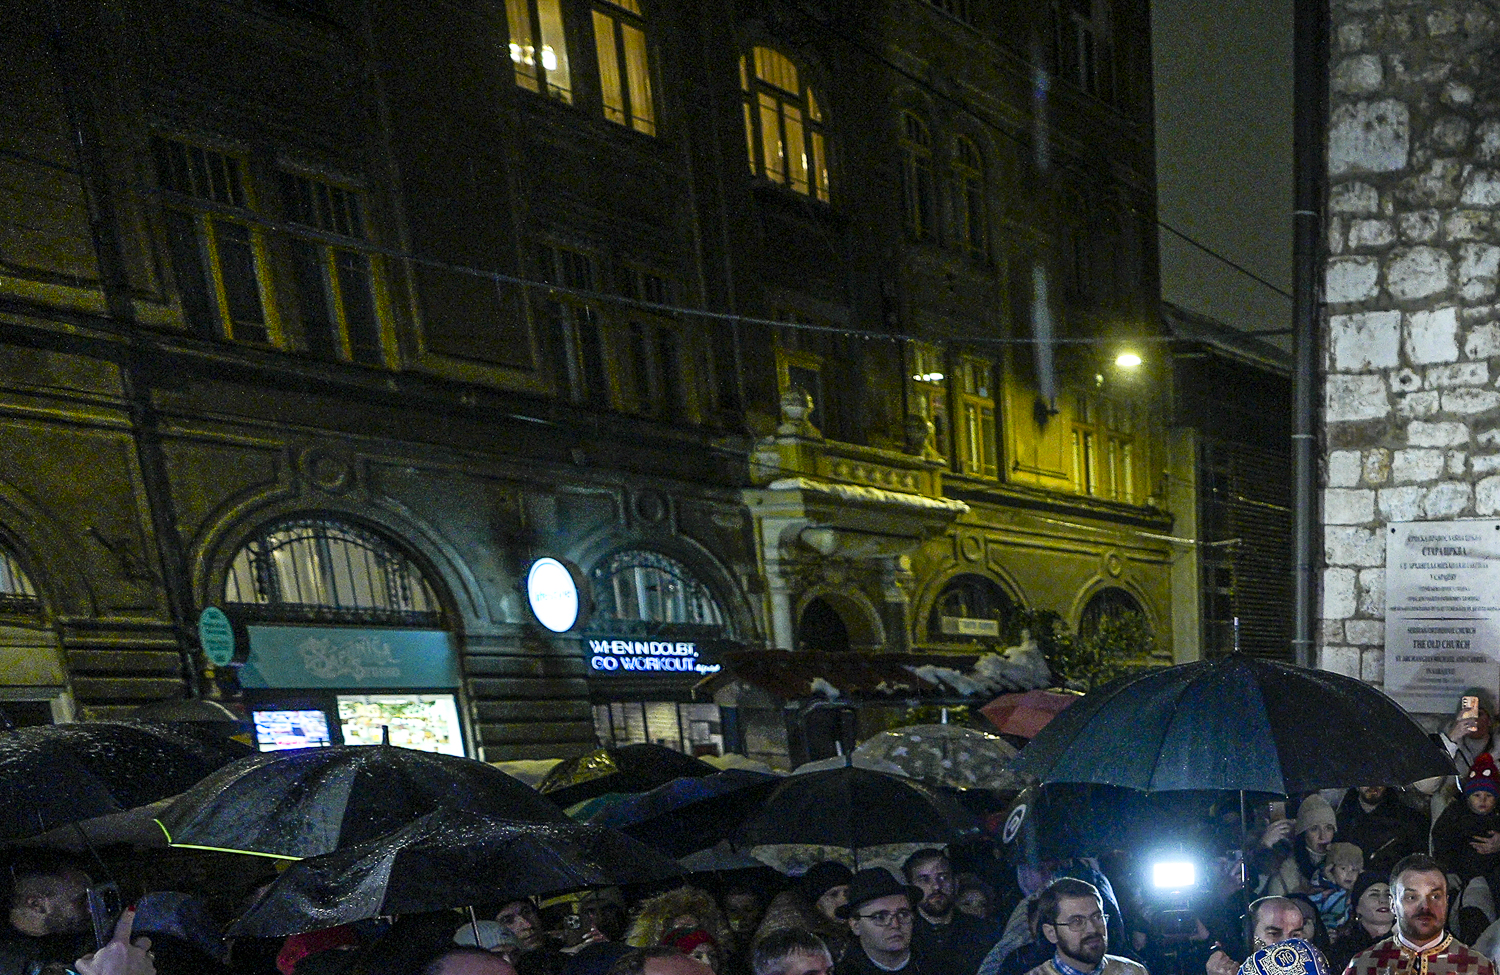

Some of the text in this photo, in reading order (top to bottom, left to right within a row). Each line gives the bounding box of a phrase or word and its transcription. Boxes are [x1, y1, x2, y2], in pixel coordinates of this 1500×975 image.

[589, 639, 635, 655] WHEN
[635, 641, 649, 655] IN
[1413, 639, 1471, 650] THE OLD CHURCH
[591, 655, 619, 671] GO
